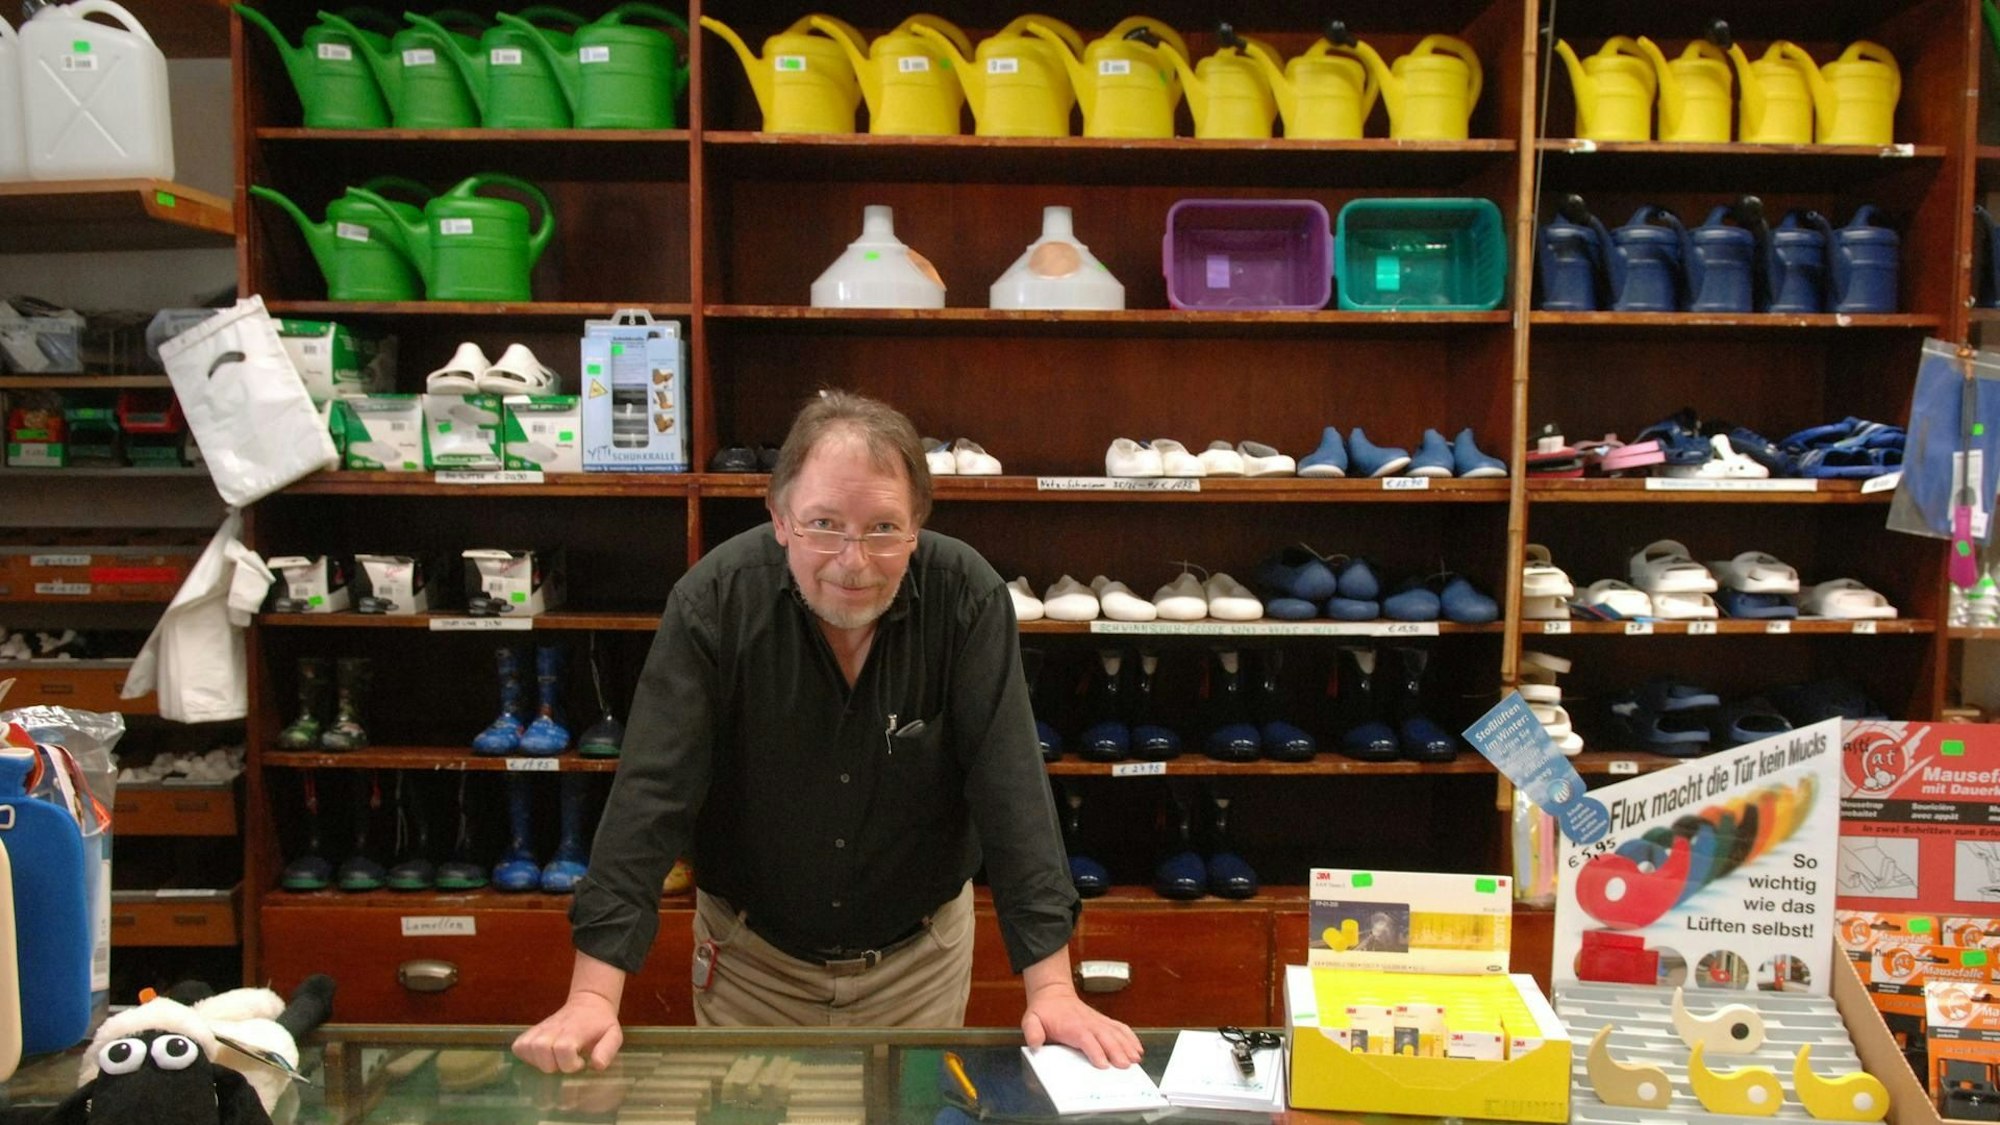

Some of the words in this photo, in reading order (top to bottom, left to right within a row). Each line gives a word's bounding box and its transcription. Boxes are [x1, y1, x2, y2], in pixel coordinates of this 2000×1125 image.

[612, 452, 675, 461] SCHUHKRALLE
[1474, 703, 1521, 743] Stoßlüften
[1496, 714, 1530, 742] Winter:
[1922, 766, 2000, 783] Mausef
[1608, 798, 1647, 835] Flux
[1651, 772, 1704, 819] macht
[1706, 765, 1730, 797] die
[1733, 755, 1757, 787] Tür
[1758, 745, 1787, 778] kein
[1787, 732, 1828, 767] Mucks
[1921, 782, 1946, 794] mit
[1568, 855, 1580, 868] €
[1793, 853, 1818, 869] So
[1316, 872, 1331, 881] 3M
[1748, 875, 1817, 896] wichtig
[1743, 897, 1776, 912] wie
[1781, 898, 1816, 915] das
[1686, 915, 1746, 934] Lüften
[1752, 921, 1814, 939] selbst!
[1922, 966, 1985, 977] Mausefalle
